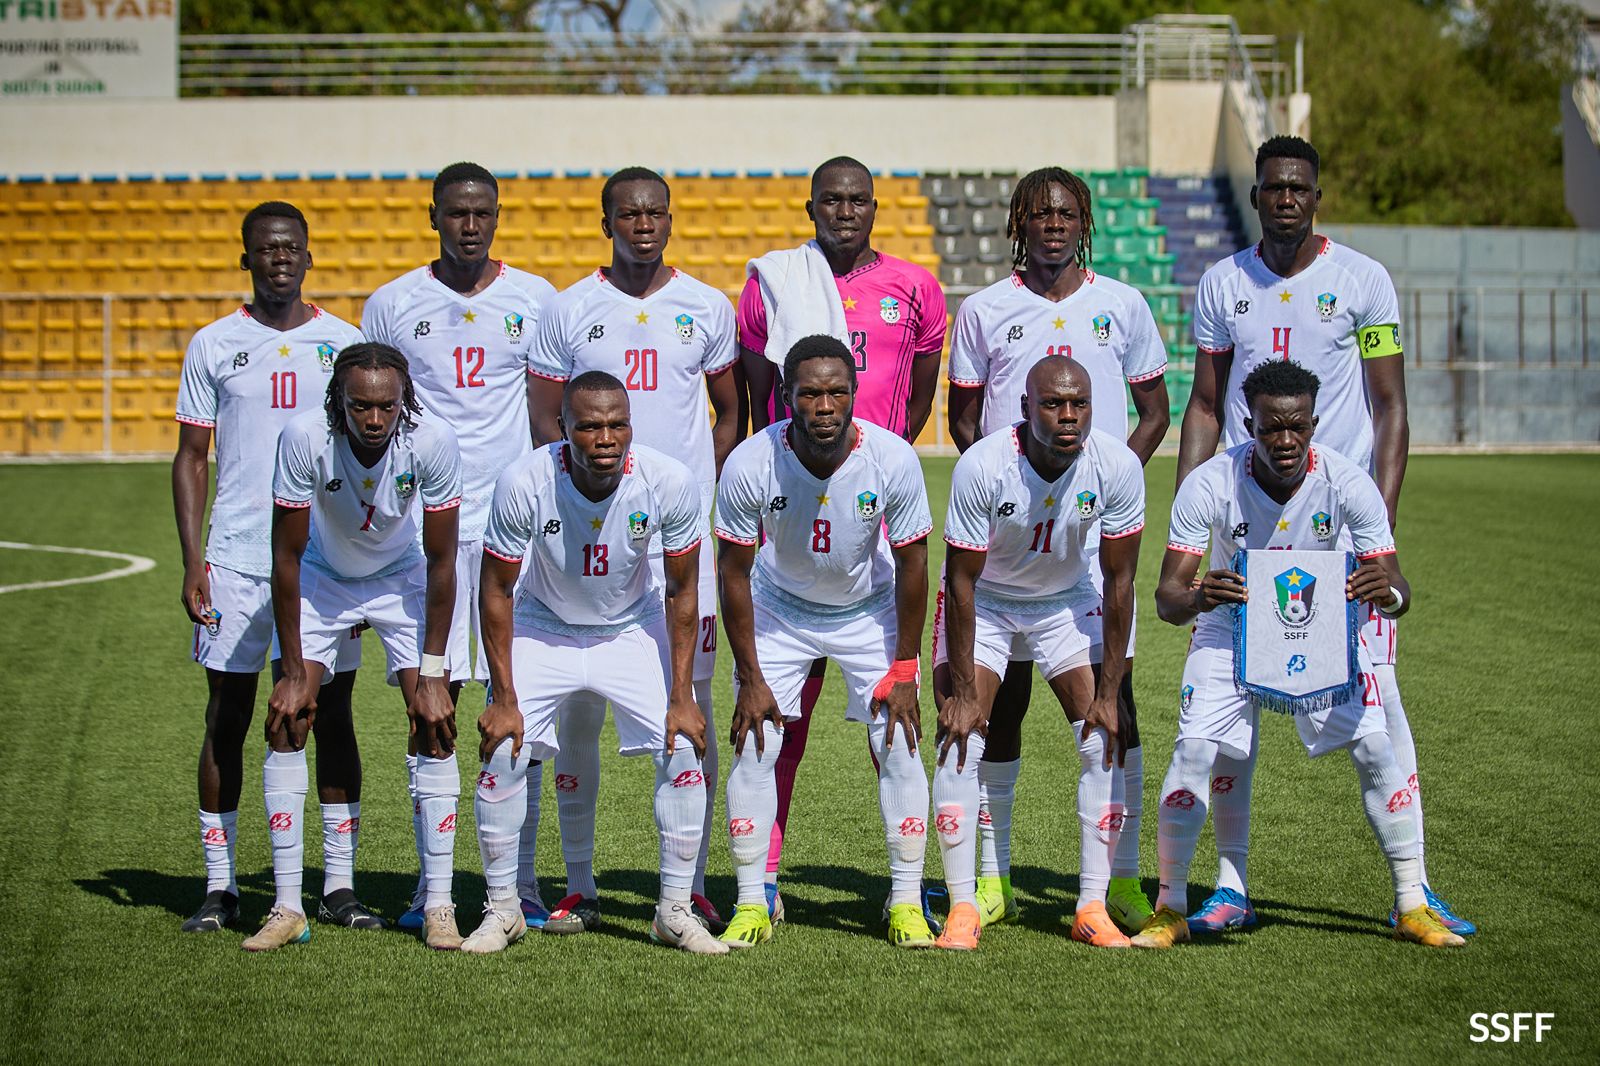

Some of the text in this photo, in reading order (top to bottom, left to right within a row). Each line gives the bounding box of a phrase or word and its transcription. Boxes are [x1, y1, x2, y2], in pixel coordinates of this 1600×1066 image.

[849, 332, 867, 372] 3
[1272, 327, 1292, 362] 4
[453, 346, 486, 388] 12
[625, 349, 657, 391] 20
[270, 372, 297, 409] 10
[360, 500, 375, 531] 7
[813, 519, 830, 553] 8
[1029, 519, 1055, 553] 11
[582, 544, 608, 576] 13
[1284, 632, 1308, 640] SSFF
[1357, 672, 1383, 707] 21
